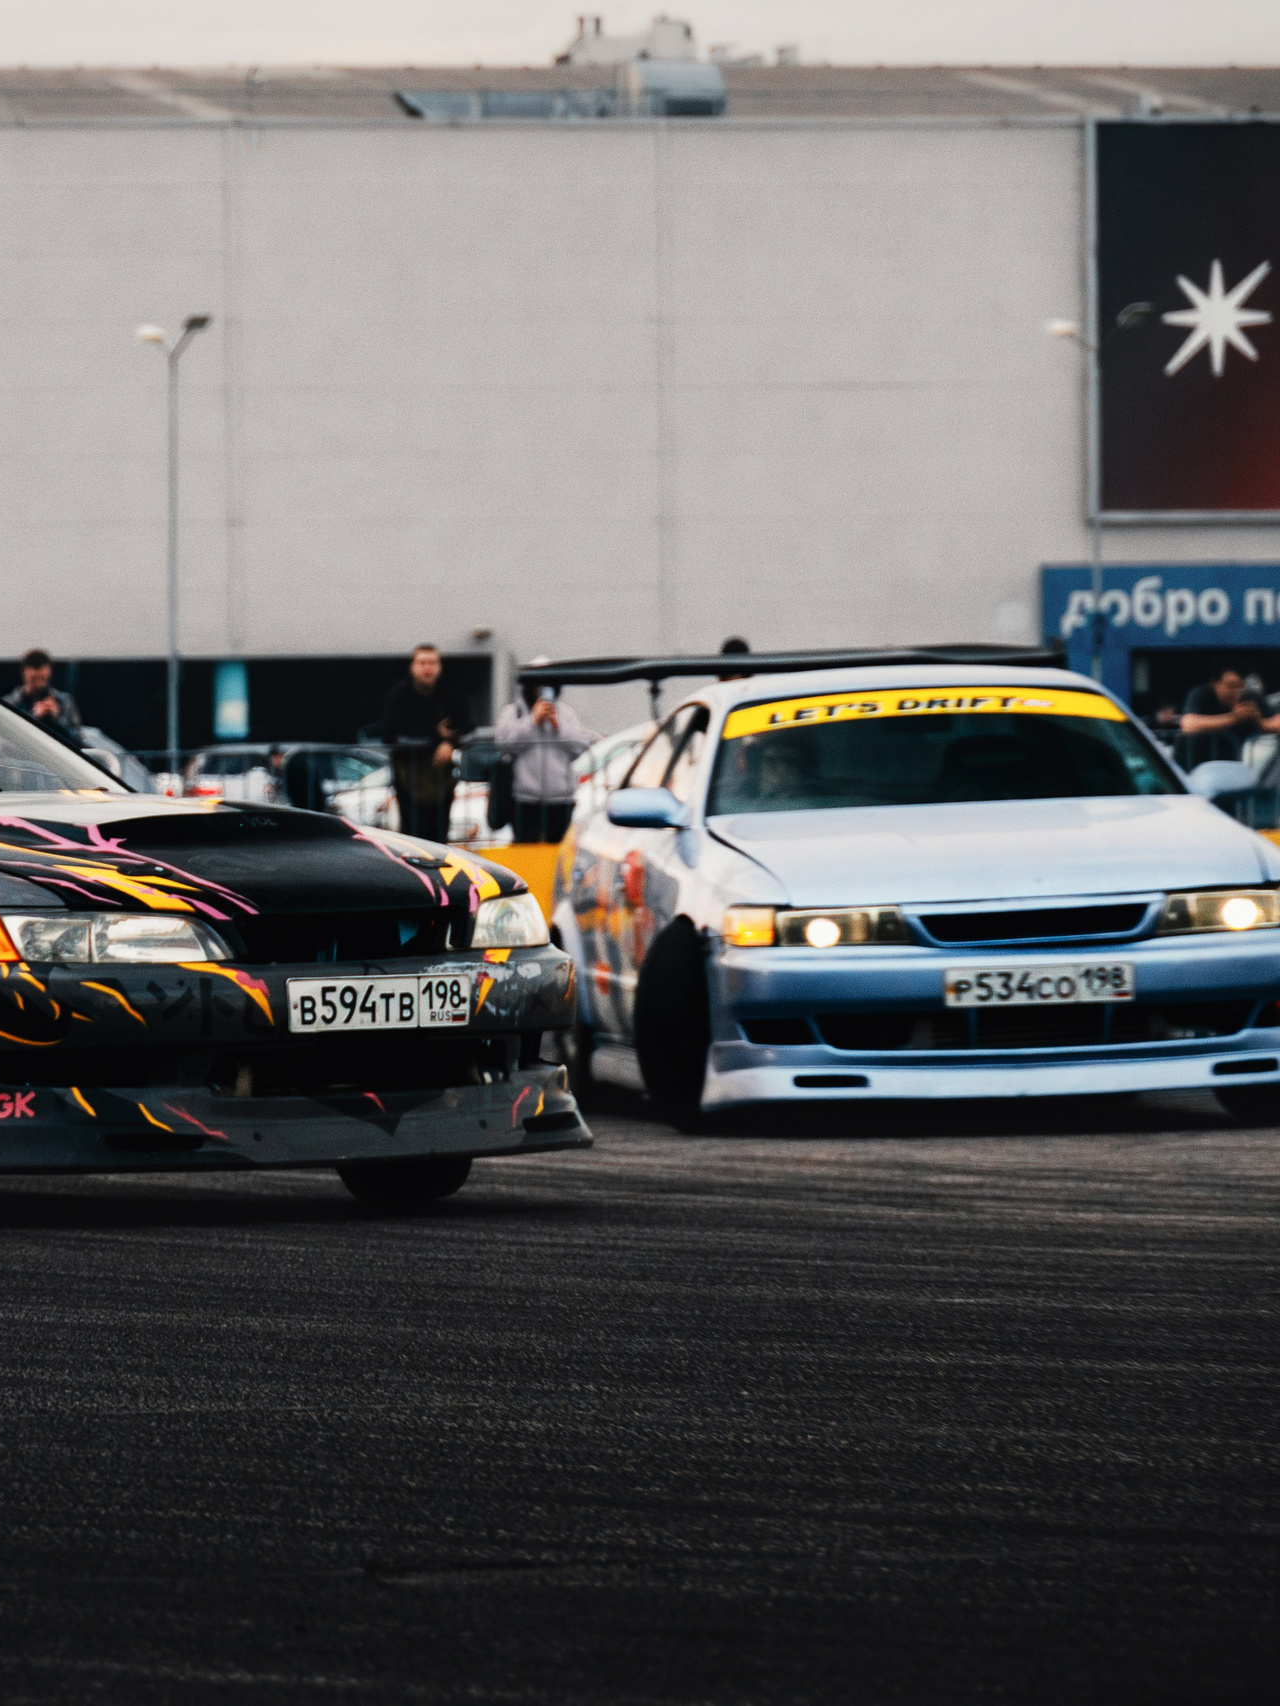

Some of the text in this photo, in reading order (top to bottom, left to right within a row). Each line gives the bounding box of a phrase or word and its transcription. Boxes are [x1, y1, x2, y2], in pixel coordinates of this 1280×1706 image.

[1243, 587, 1280, 626] п
[768, 699, 880, 726] LET'S
[897, 696, 1022, 712] DRIFT
[1081, 966, 1126, 989] 198
[299, 979, 462, 1026] В594ТВ 198
[430, 1009, 452, 1023] RUS
